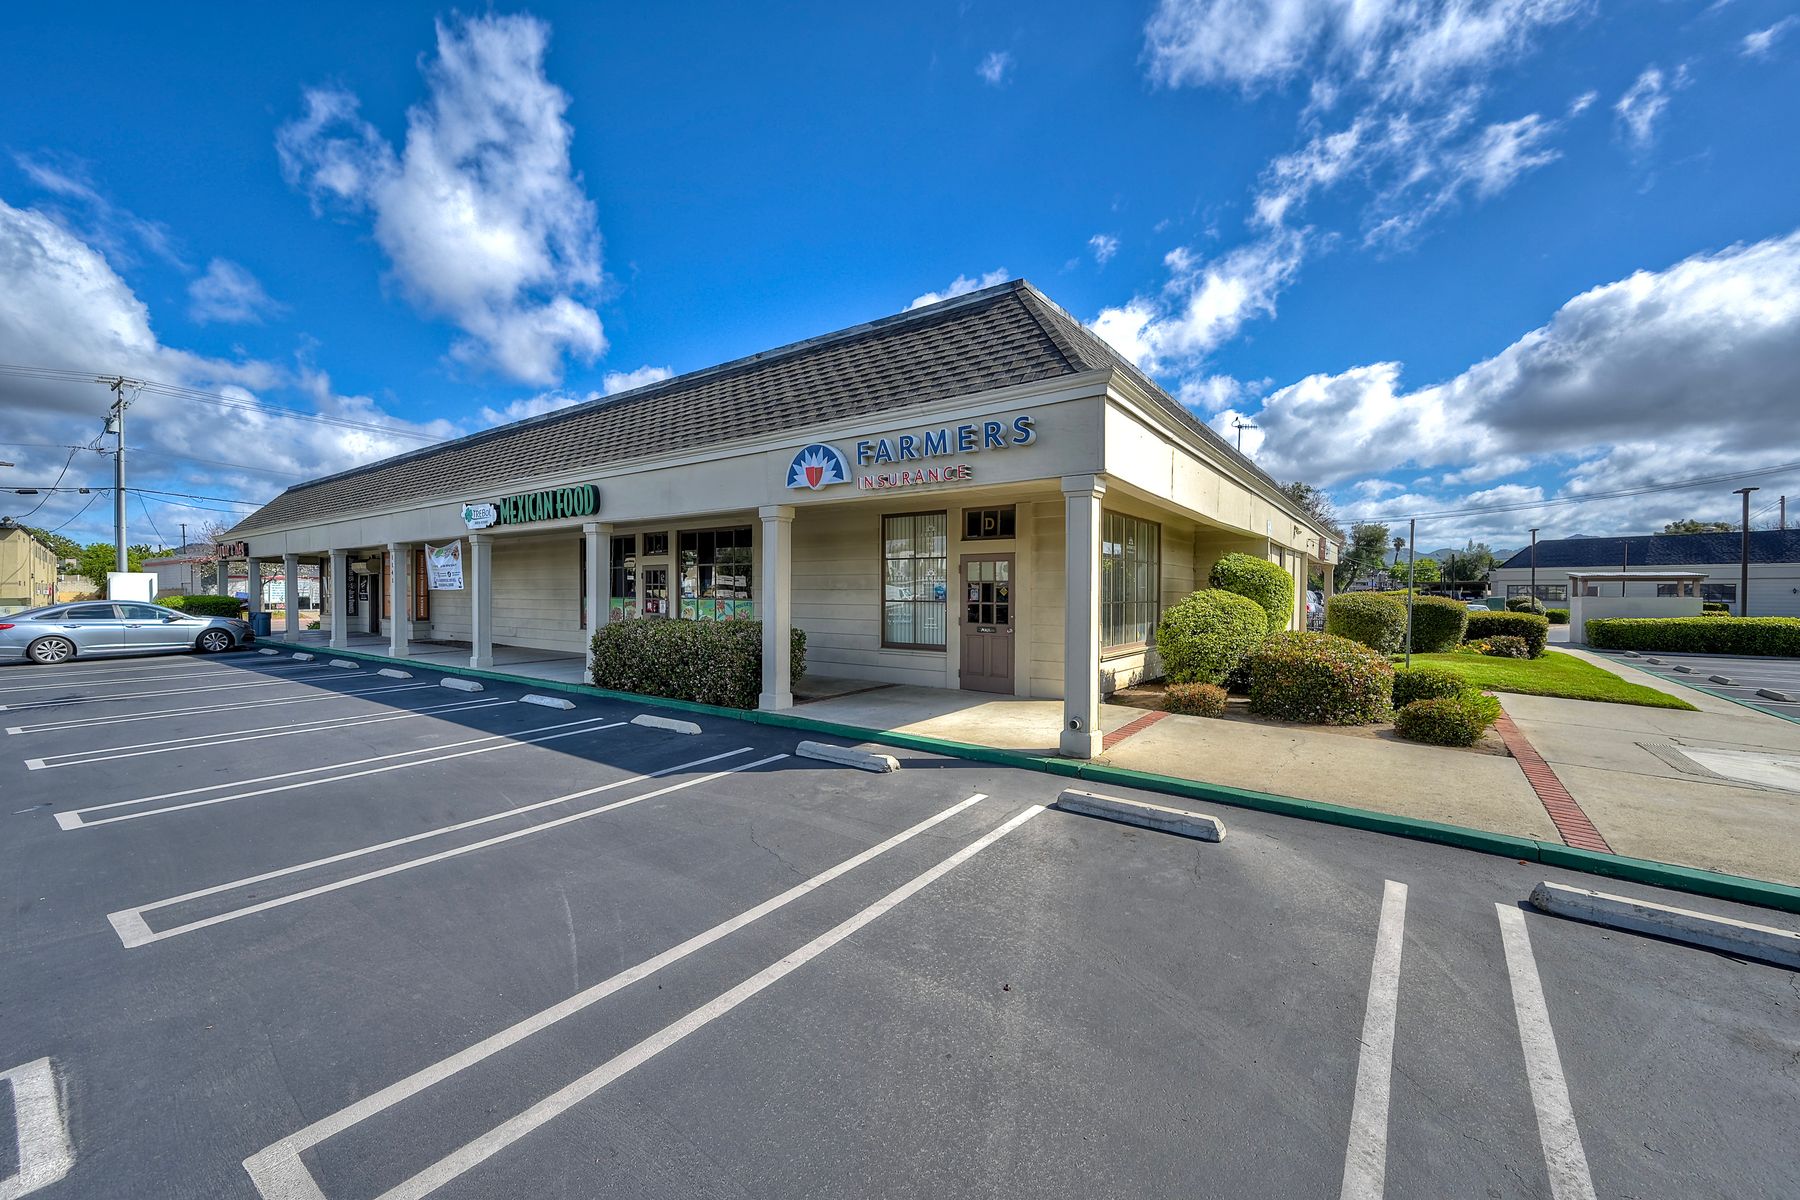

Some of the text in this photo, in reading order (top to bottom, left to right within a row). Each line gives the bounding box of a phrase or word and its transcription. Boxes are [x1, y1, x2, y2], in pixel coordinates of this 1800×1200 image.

[857, 416, 1036, 466] FARMERS
[858, 464, 971, 490] INSURANCE
[500, 484, 596, 525] MEXICAN FOOD
[984, 517, 995, 530] D
